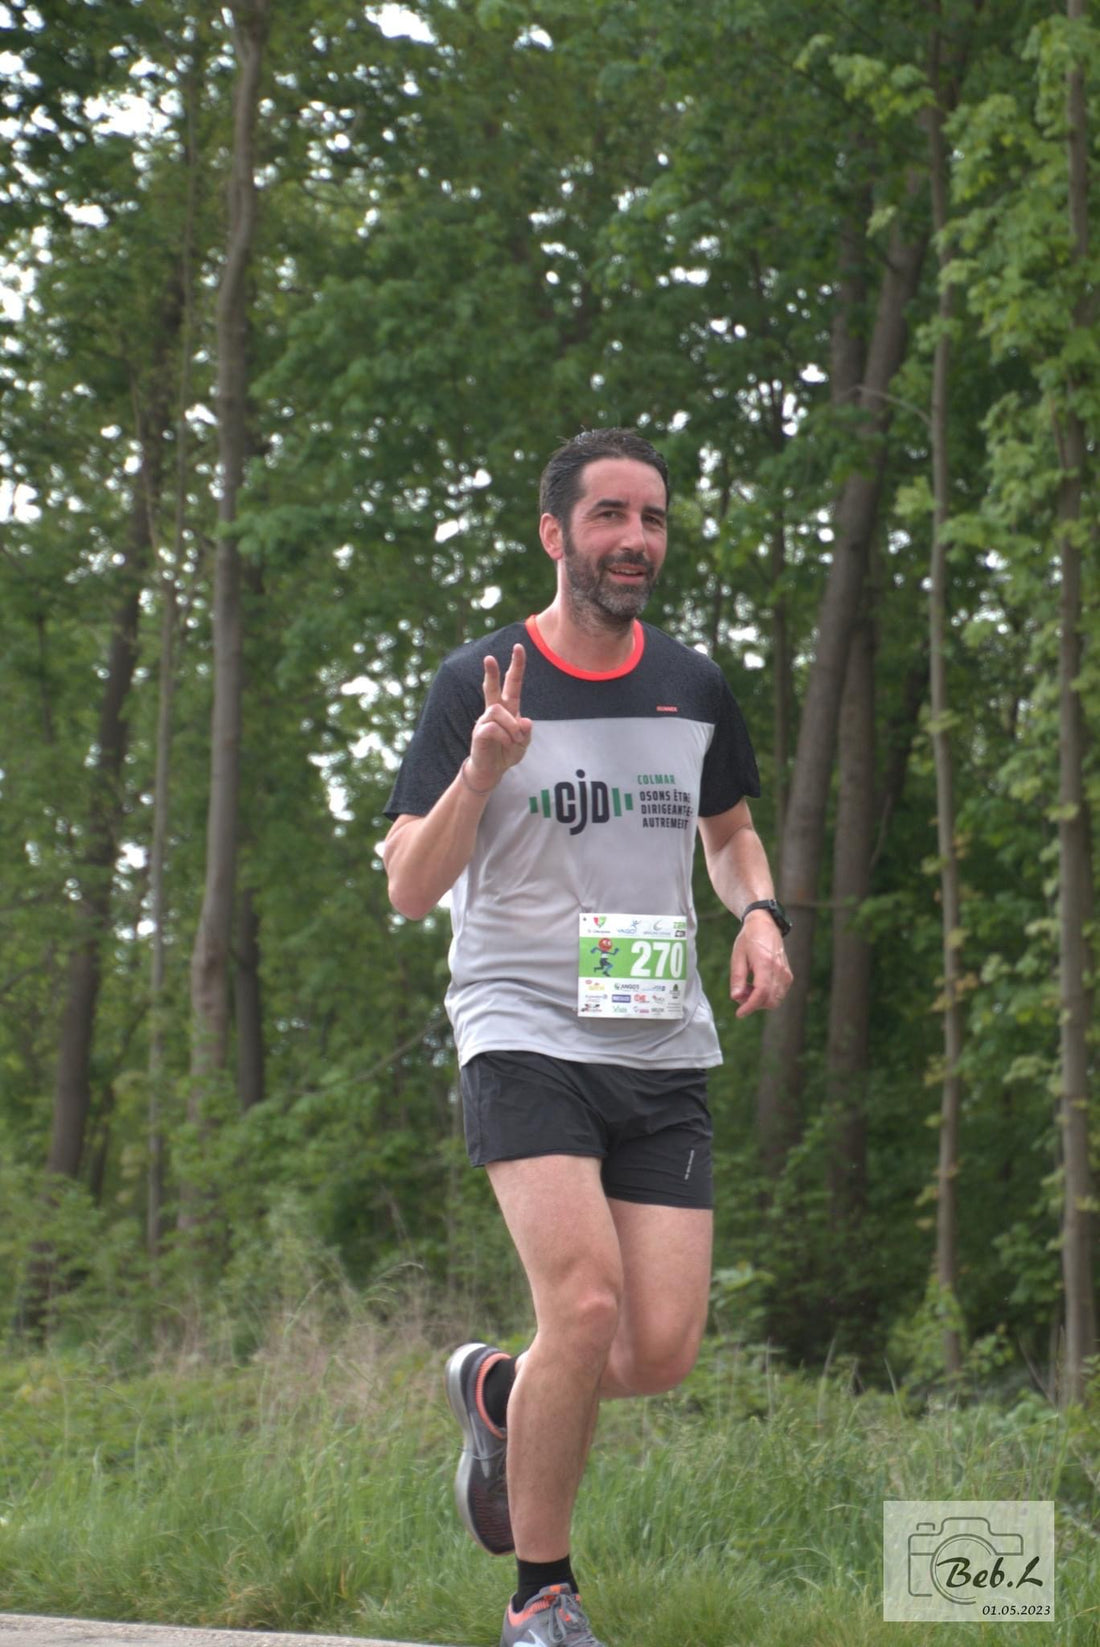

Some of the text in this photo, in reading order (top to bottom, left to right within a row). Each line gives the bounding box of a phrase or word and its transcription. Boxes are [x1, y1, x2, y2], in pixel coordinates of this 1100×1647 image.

[637, 774, 676, 785] COLMAR
[640, 790, 671, 801] OSONS
[630, 940, 684, 979] 270
